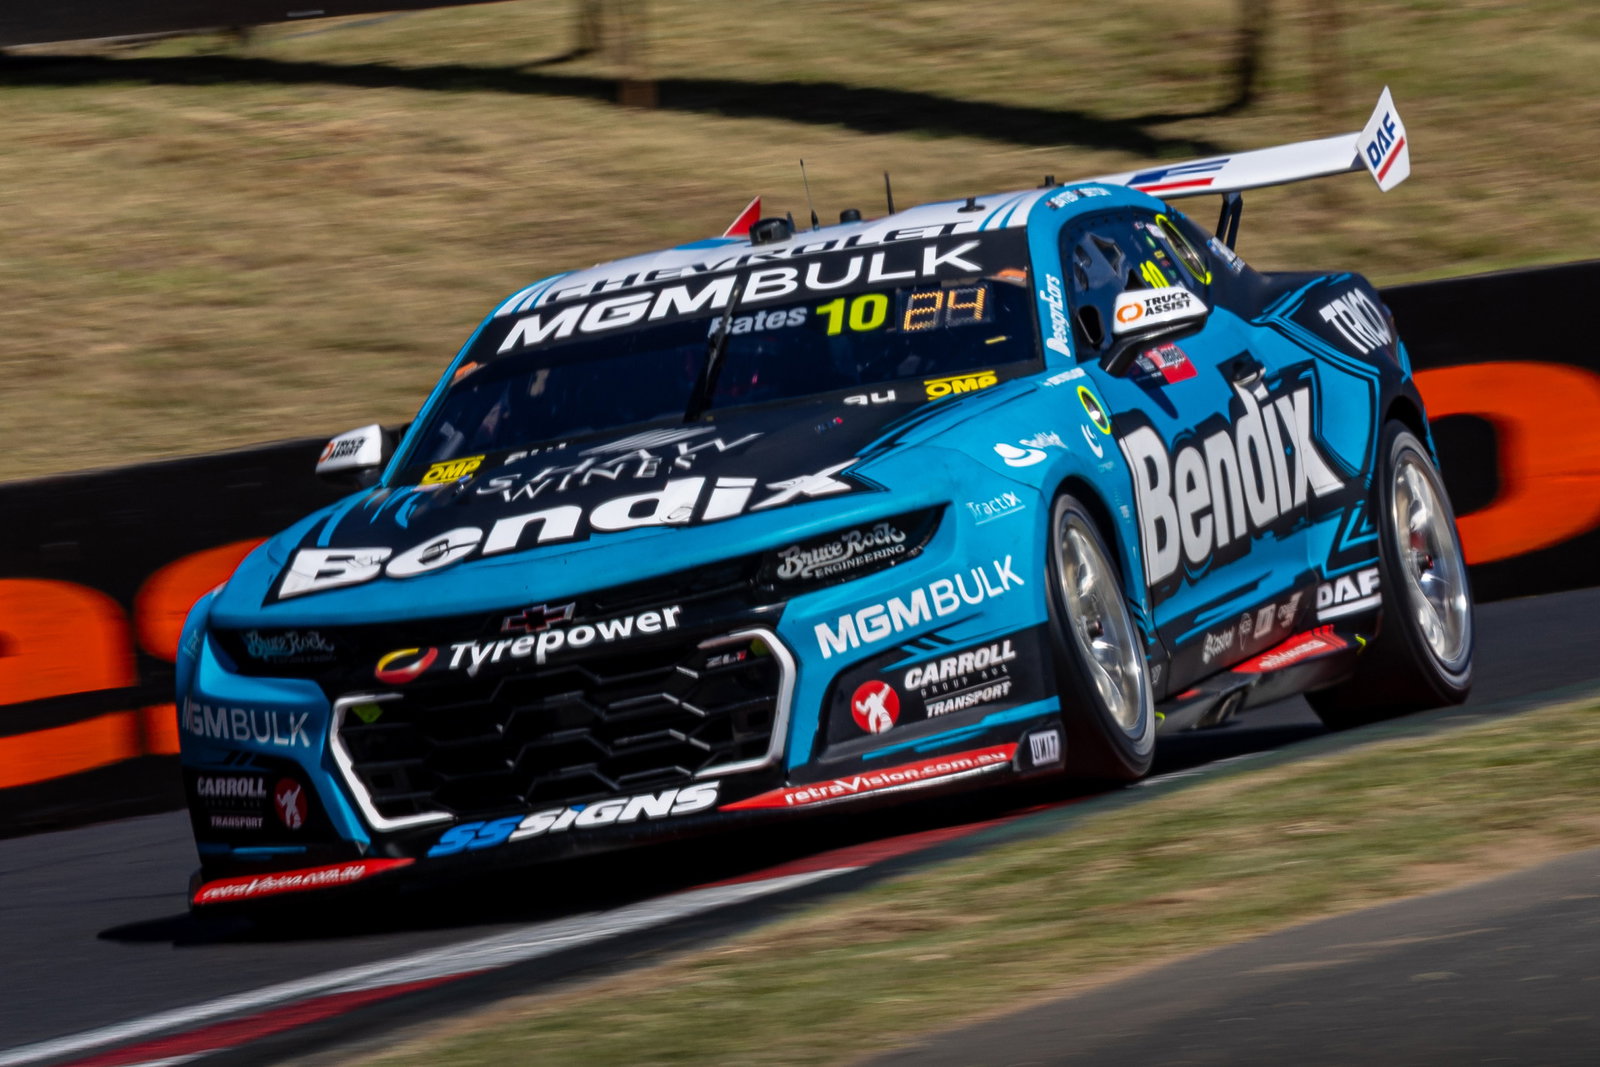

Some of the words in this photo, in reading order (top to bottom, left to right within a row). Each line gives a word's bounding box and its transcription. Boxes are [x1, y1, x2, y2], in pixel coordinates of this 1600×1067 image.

[1366, 111, 1396, 170] DAF
[496, 240, 983, 355] MGMBULK
[816, 293, 888, 336] 10
[904, 287, 985, 331] 24
[1144, 292, 1190, 307] TRUCK
[1144, 299, 1191, 317] ASSIST
[926, 375, 998, 396] OMP
[422, 460, 481, 482] OMP
[1119, 380, 1346, 588] Bendix
[277, 458, 860, 600] Bendix
[777, 541, 844, 580] Bruce
[841, 522, 907, 555] Rock
[814, 544, 906, 579] ENGINEERING
[814, 554, 1025, 659] MGMBULK
[1317, 567, 1381, 610] DAF
[449, 604, 681, 678] Tyrepower
[904, 639, 1017, 691] CARROLL
[920, 676, 970, 698] GROUP
[981, 664, 1010, 679] AUS
[926, 681, 1013, 719] TRANSPORT
[182, 696, 311, 748] MGMBULK
[197, 776, 267, 797] CARROLL
[784, 749, 1007, 806] retraVision.com.au
[210, 816, 264, 830] TRANSPORT
